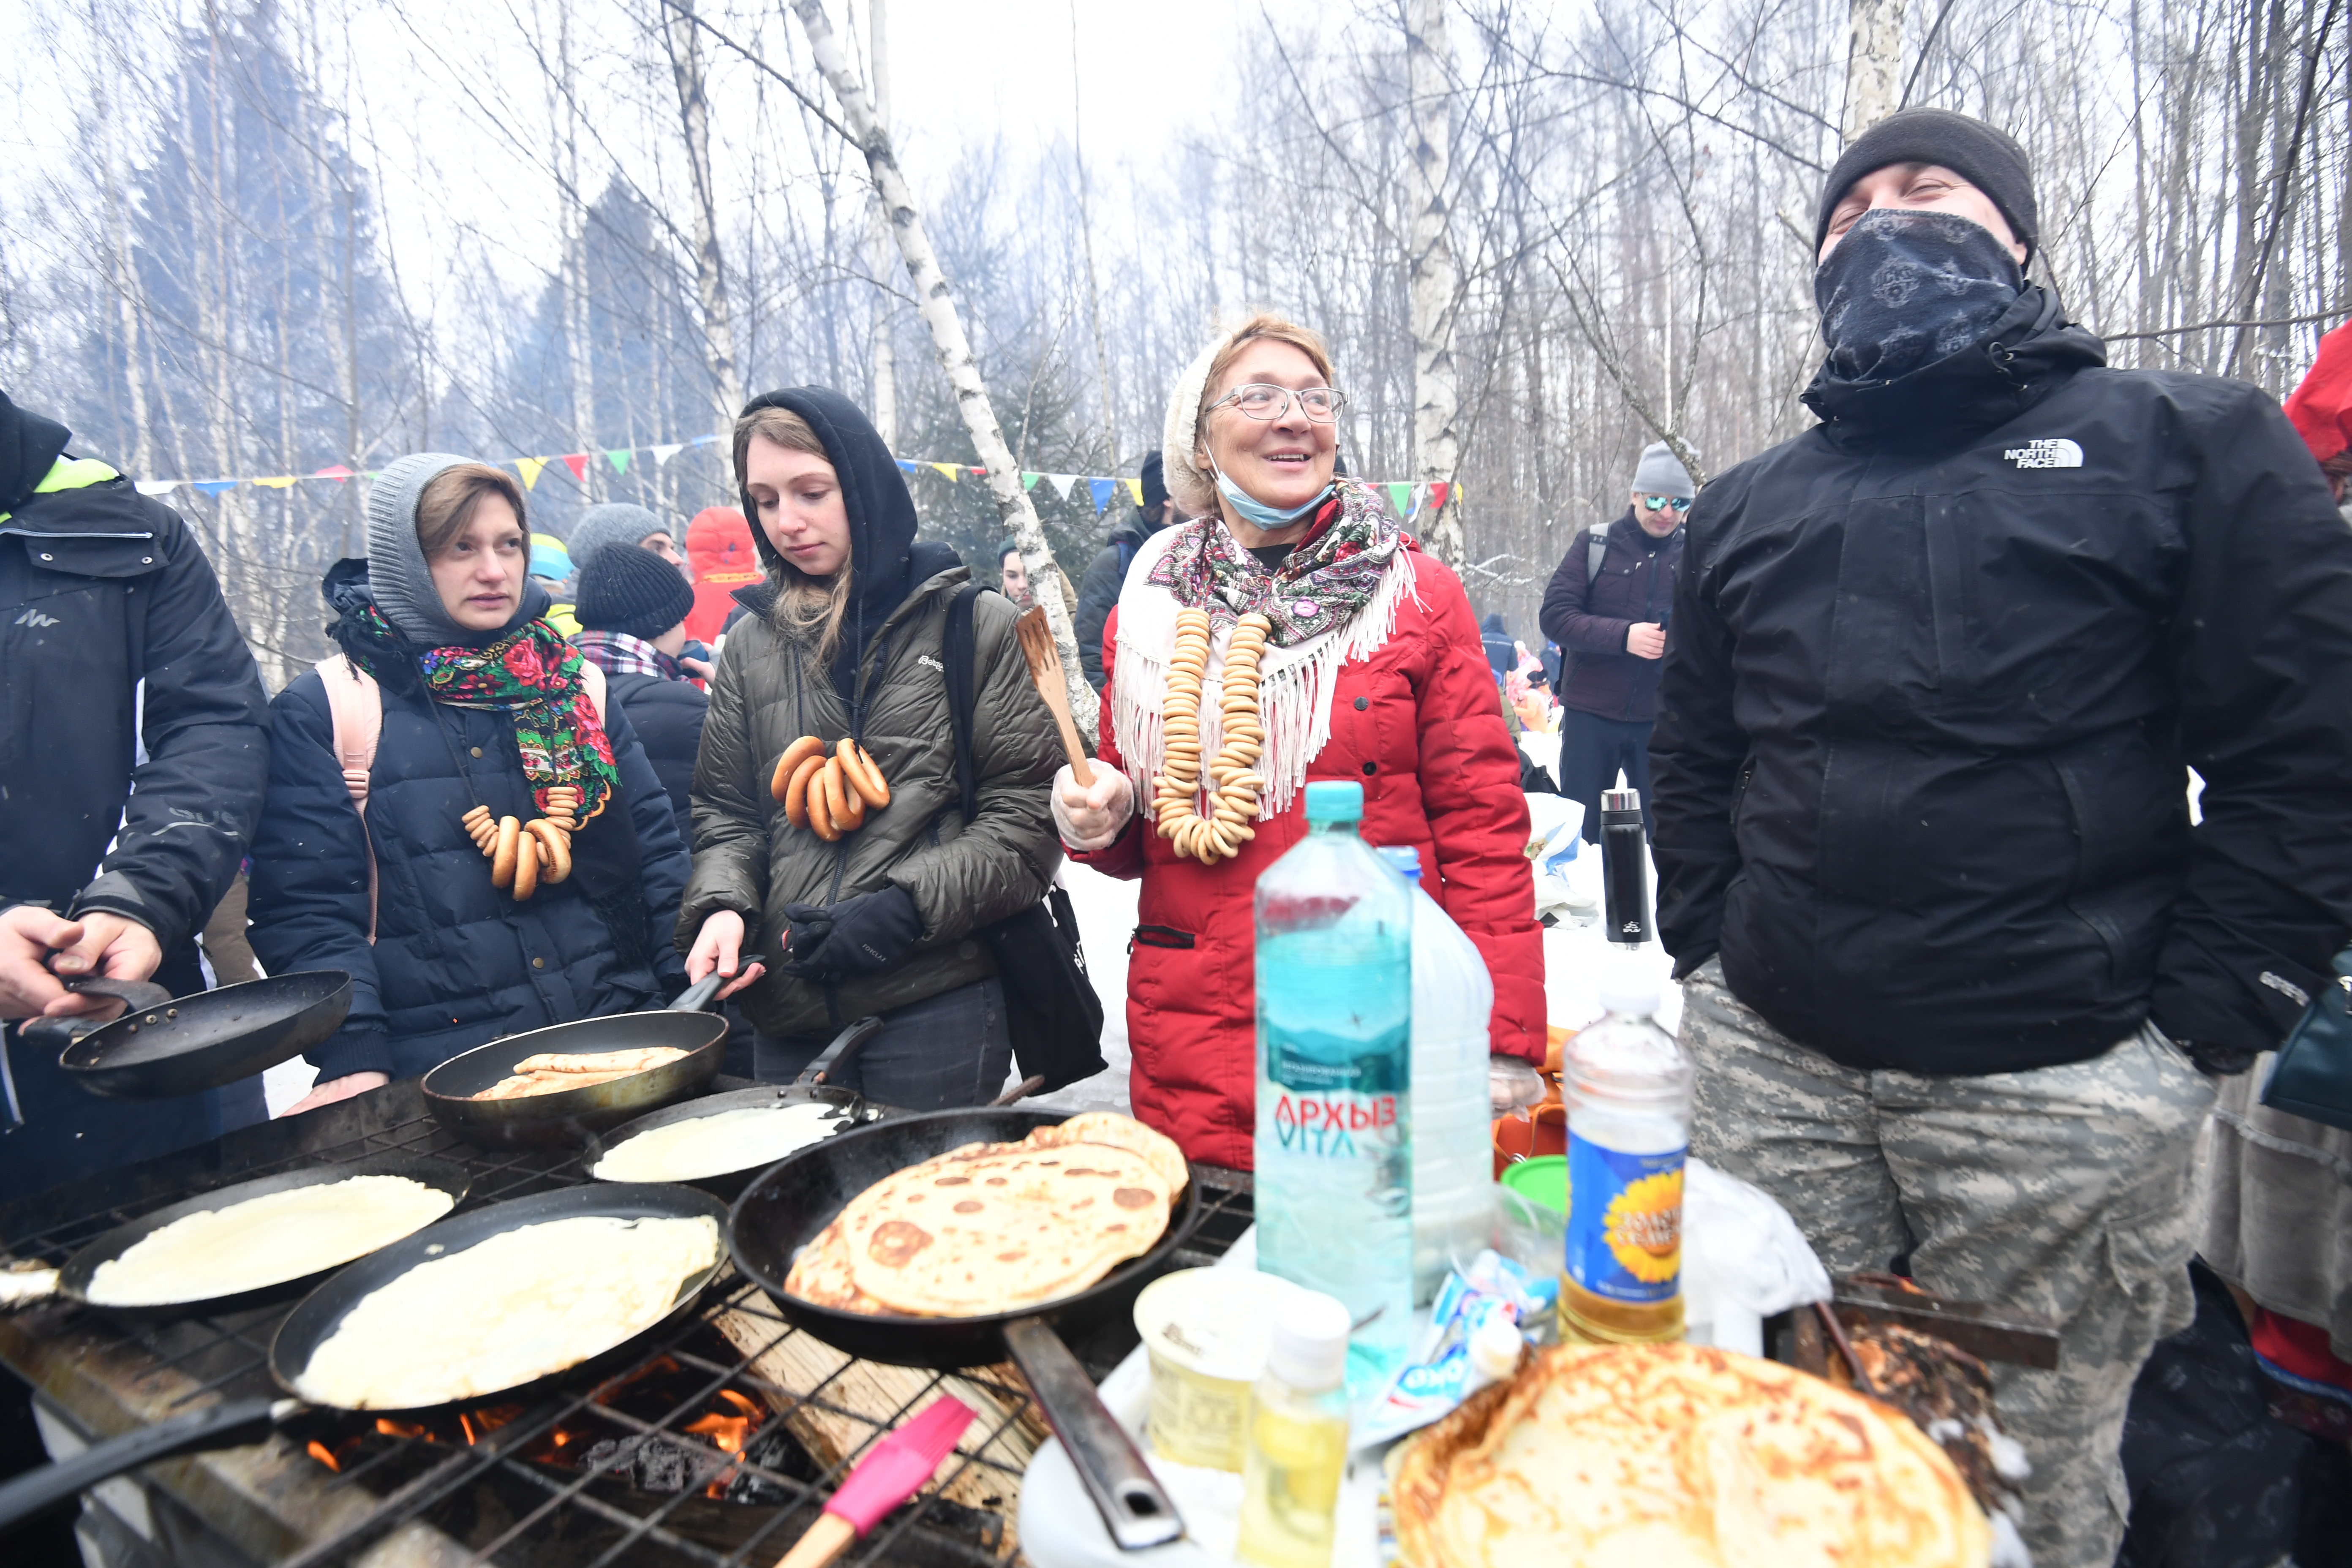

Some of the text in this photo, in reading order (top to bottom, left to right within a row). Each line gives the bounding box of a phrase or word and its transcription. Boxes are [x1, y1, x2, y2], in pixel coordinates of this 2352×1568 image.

[2028, 438, 2057, 449] THE
[2004, 449, 2057, 460] NORTH
[2016, 458, 2055, 469] FACE
[862, 943, 886, 962] FORCLAZ
[1275, 1094, 1397, 1132] АРХЫЗ
